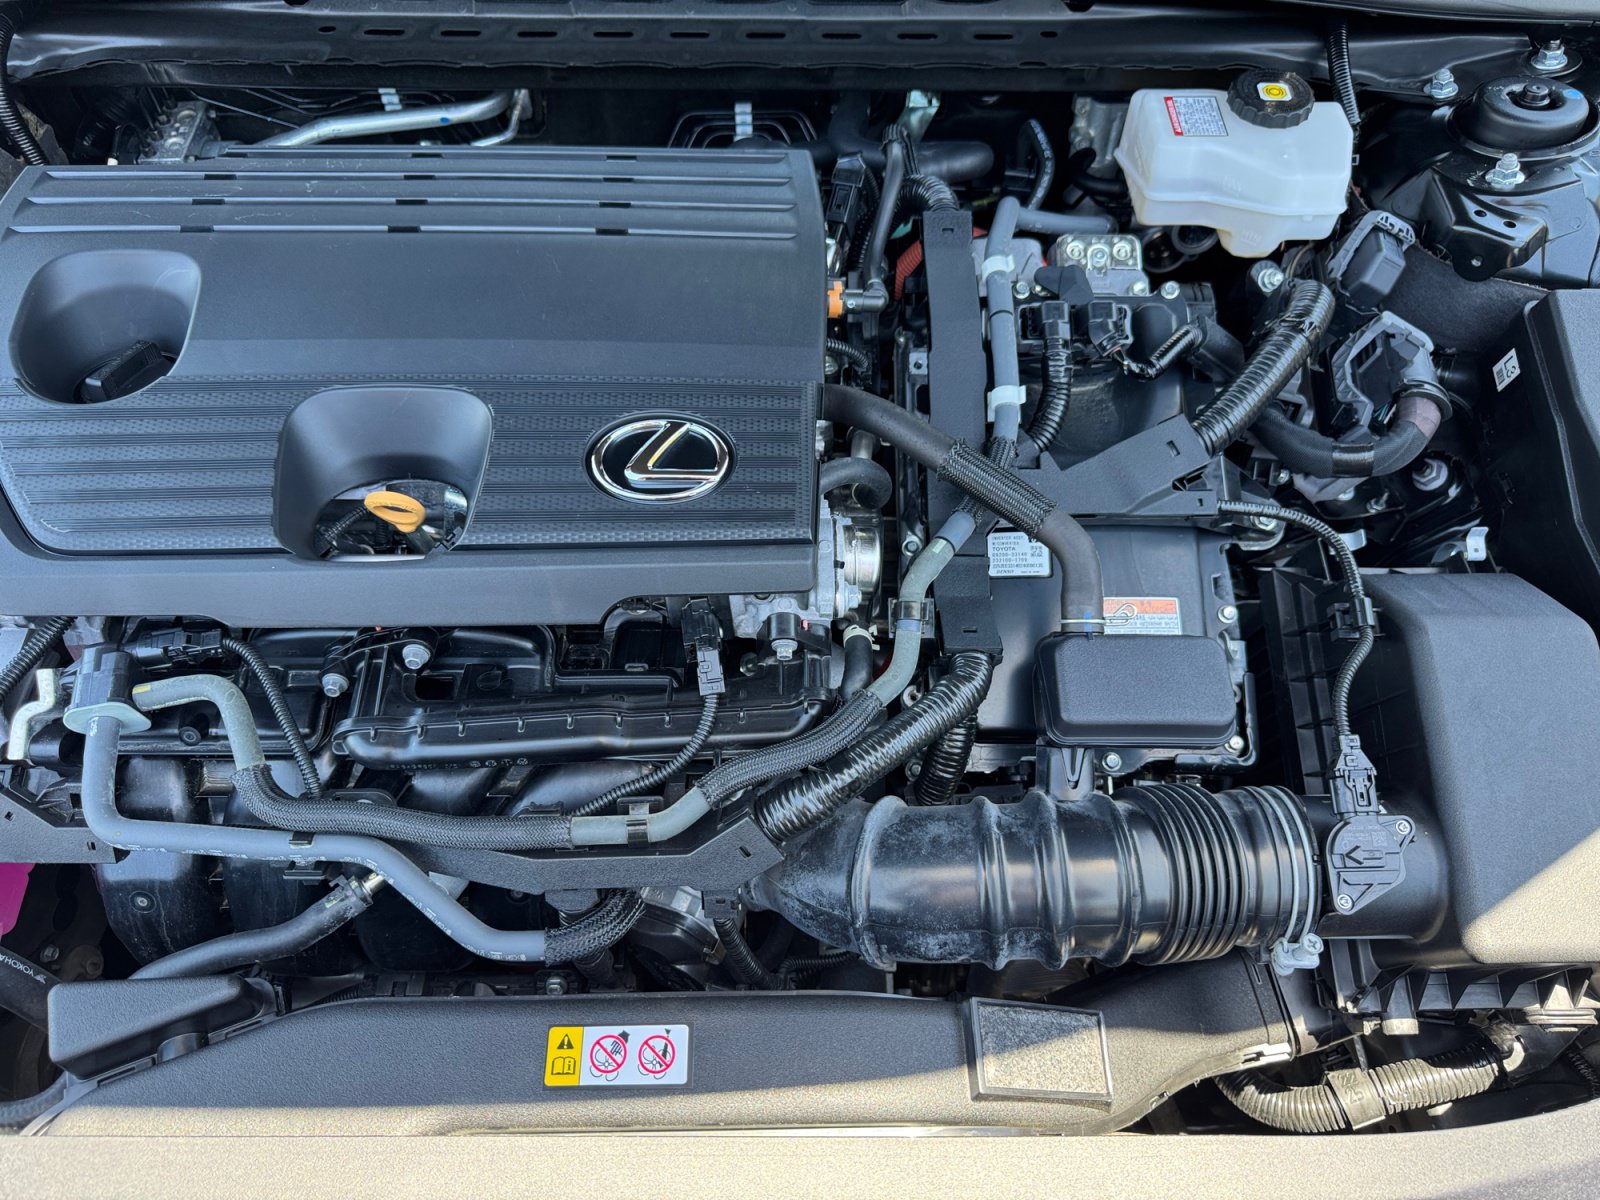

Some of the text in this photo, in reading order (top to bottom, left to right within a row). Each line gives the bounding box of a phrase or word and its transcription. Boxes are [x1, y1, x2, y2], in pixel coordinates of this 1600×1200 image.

[1504, 355, 1516, 378] L3
[1337, 1071, 1360, 1088] 22
[1345, 1087, 1364, 1105] 25
